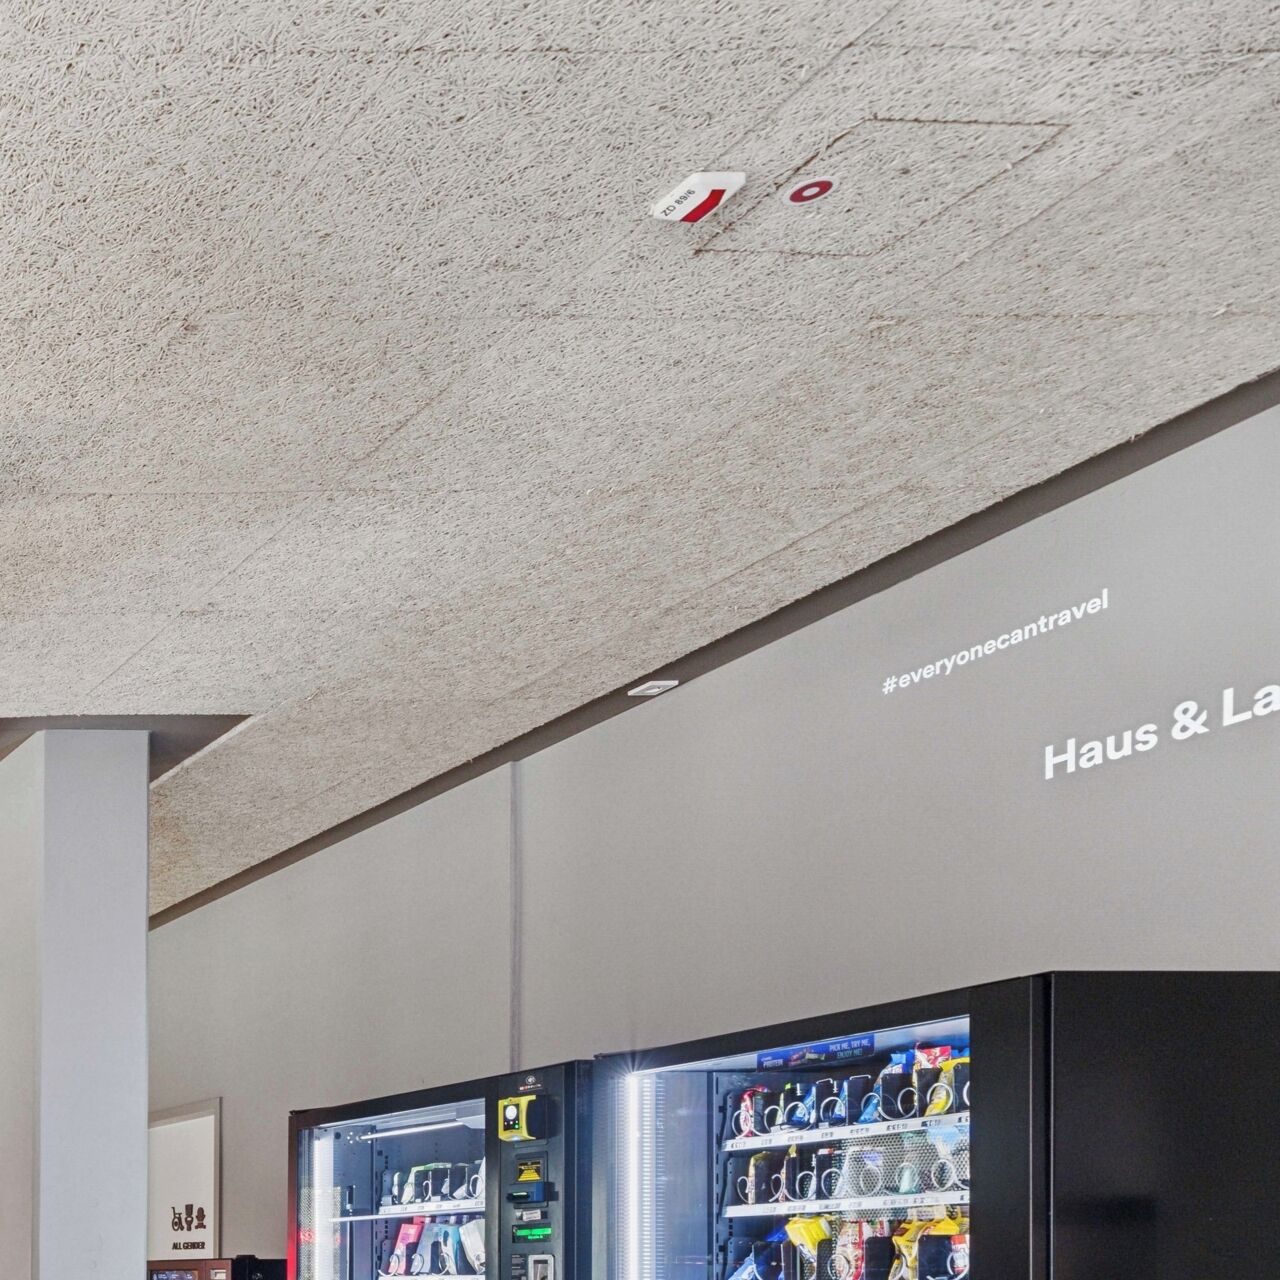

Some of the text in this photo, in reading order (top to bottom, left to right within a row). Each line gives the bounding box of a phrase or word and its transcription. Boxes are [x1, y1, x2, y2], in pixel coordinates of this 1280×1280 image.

[661, 189, 696, 217] ZD 89/6
[881, 588, 1109, 695] #everyonecantravel
[1043, 686, 1280, 780] Haus & La
